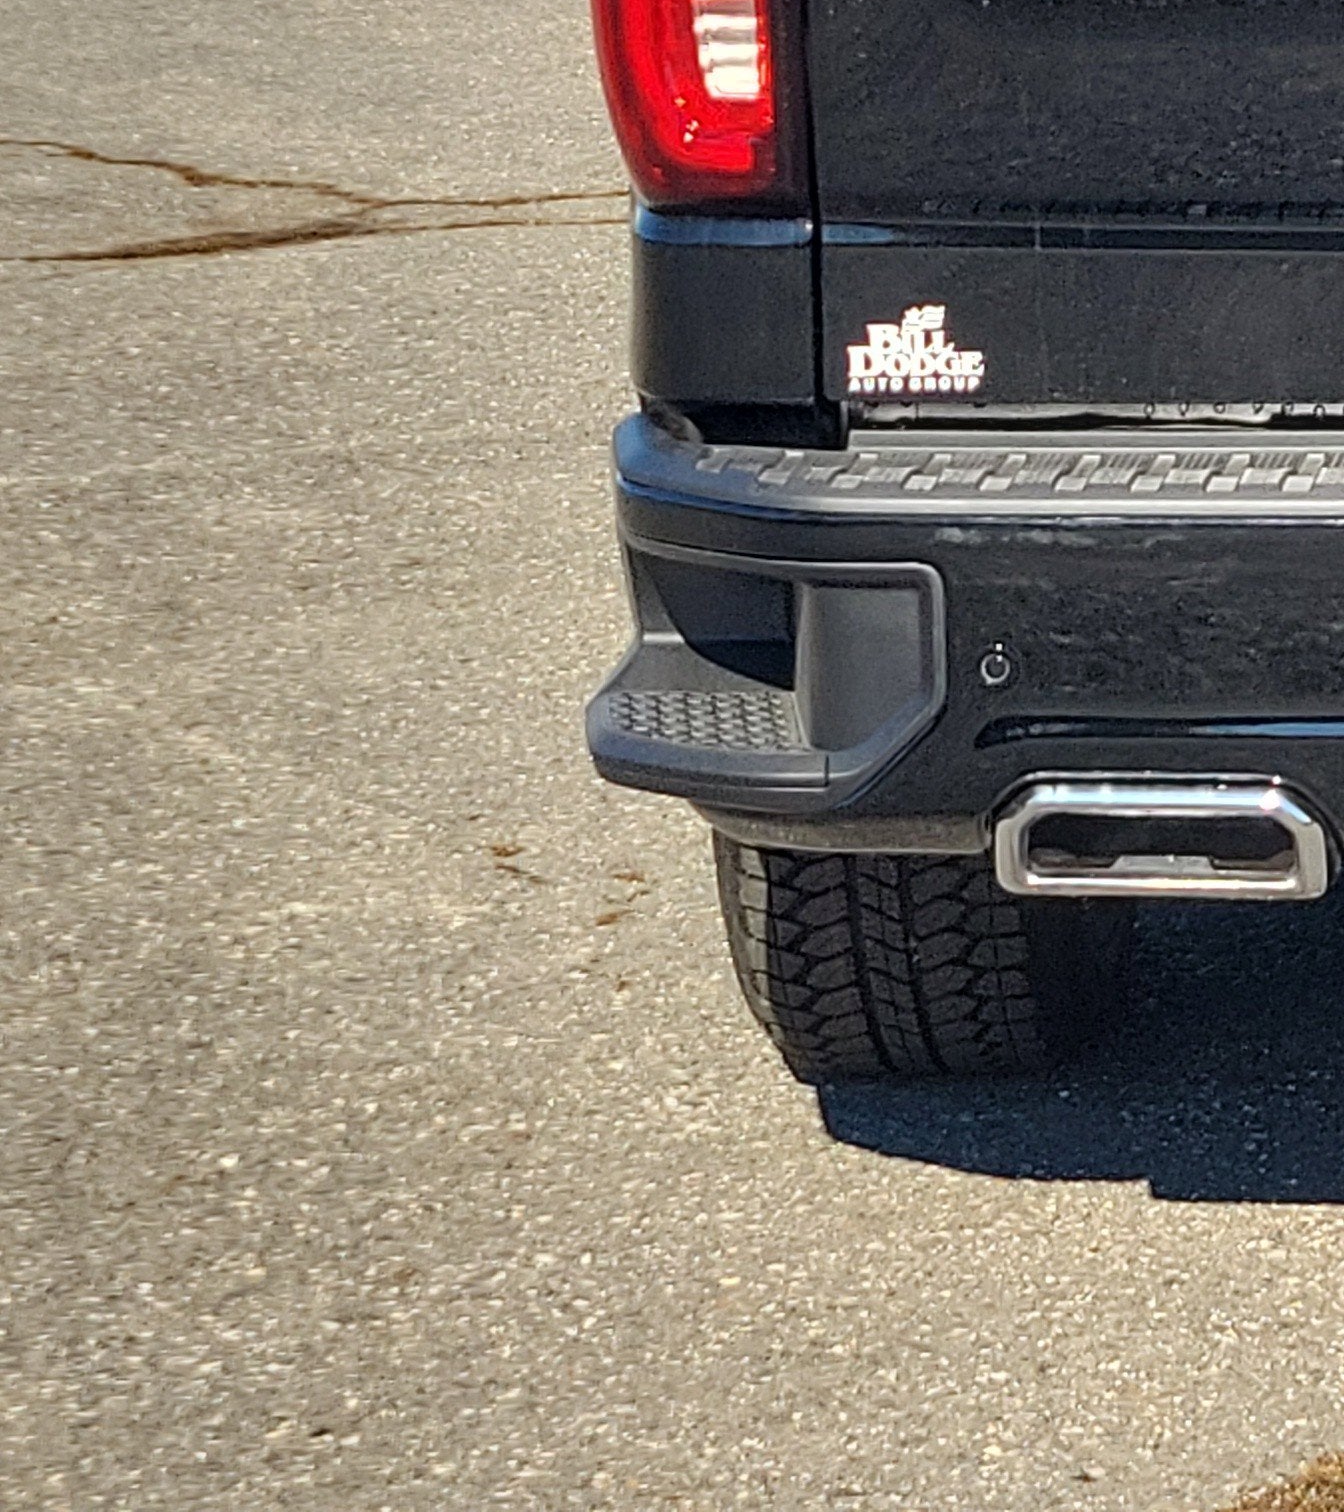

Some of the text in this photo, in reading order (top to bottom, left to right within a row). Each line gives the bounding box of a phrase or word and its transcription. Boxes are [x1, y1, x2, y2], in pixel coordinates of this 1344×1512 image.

[847, 343, 985, 377] DODGE
[848, 376, 981, 393] AUTO GROUP
